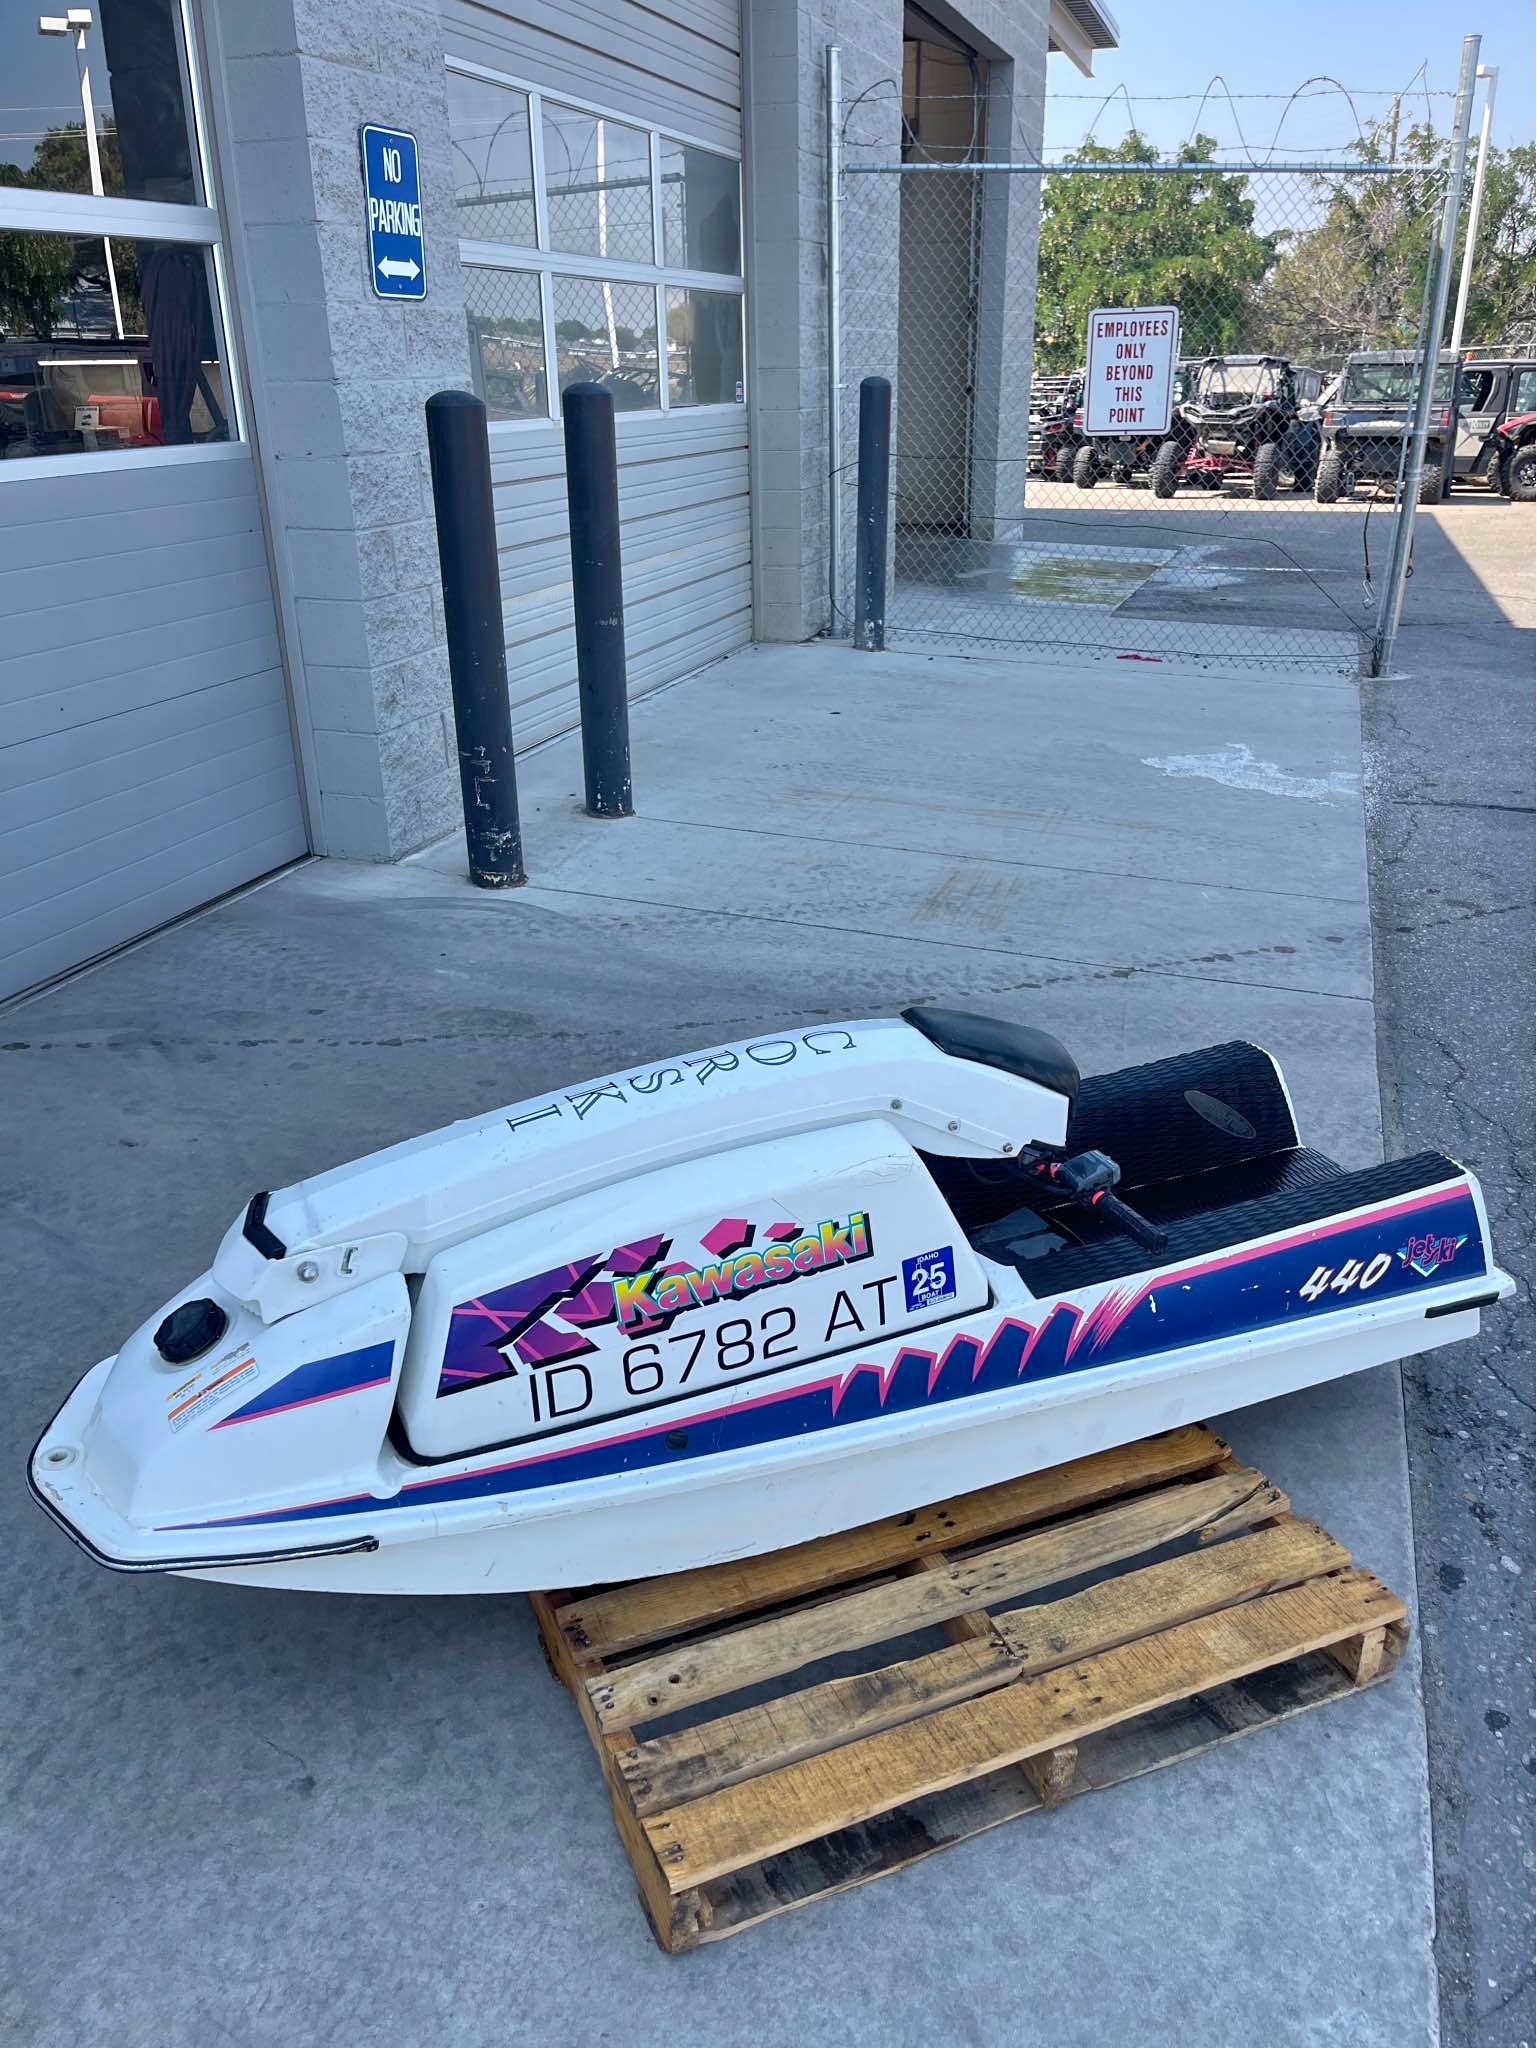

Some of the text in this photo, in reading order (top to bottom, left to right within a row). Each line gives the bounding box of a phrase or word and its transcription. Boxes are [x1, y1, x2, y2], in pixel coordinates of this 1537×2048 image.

[382, 147, 401, 183] NO
[369, 197, 421, 237] PARKING
[1097, 320, 1168, 338] EMPLOYEES
[1116, 343, 1146, 359] ONLY
[1106, 364, 1153, 381] BEYOND
[1115, 386, 1142, 402] THIS
[1109, 407, 1145, 423] POINT
[917, 1251, 939, 1263] IDAHO
[612, 1211, 871, 1327] Kawasaki
[1299, 1252, 1393, 1303] 440
[911, 1261, 947, 1297] 25
[921, 1289, 940, 1300] BOAT
[529, 1275, 898, 1422] ID 6782 AT
